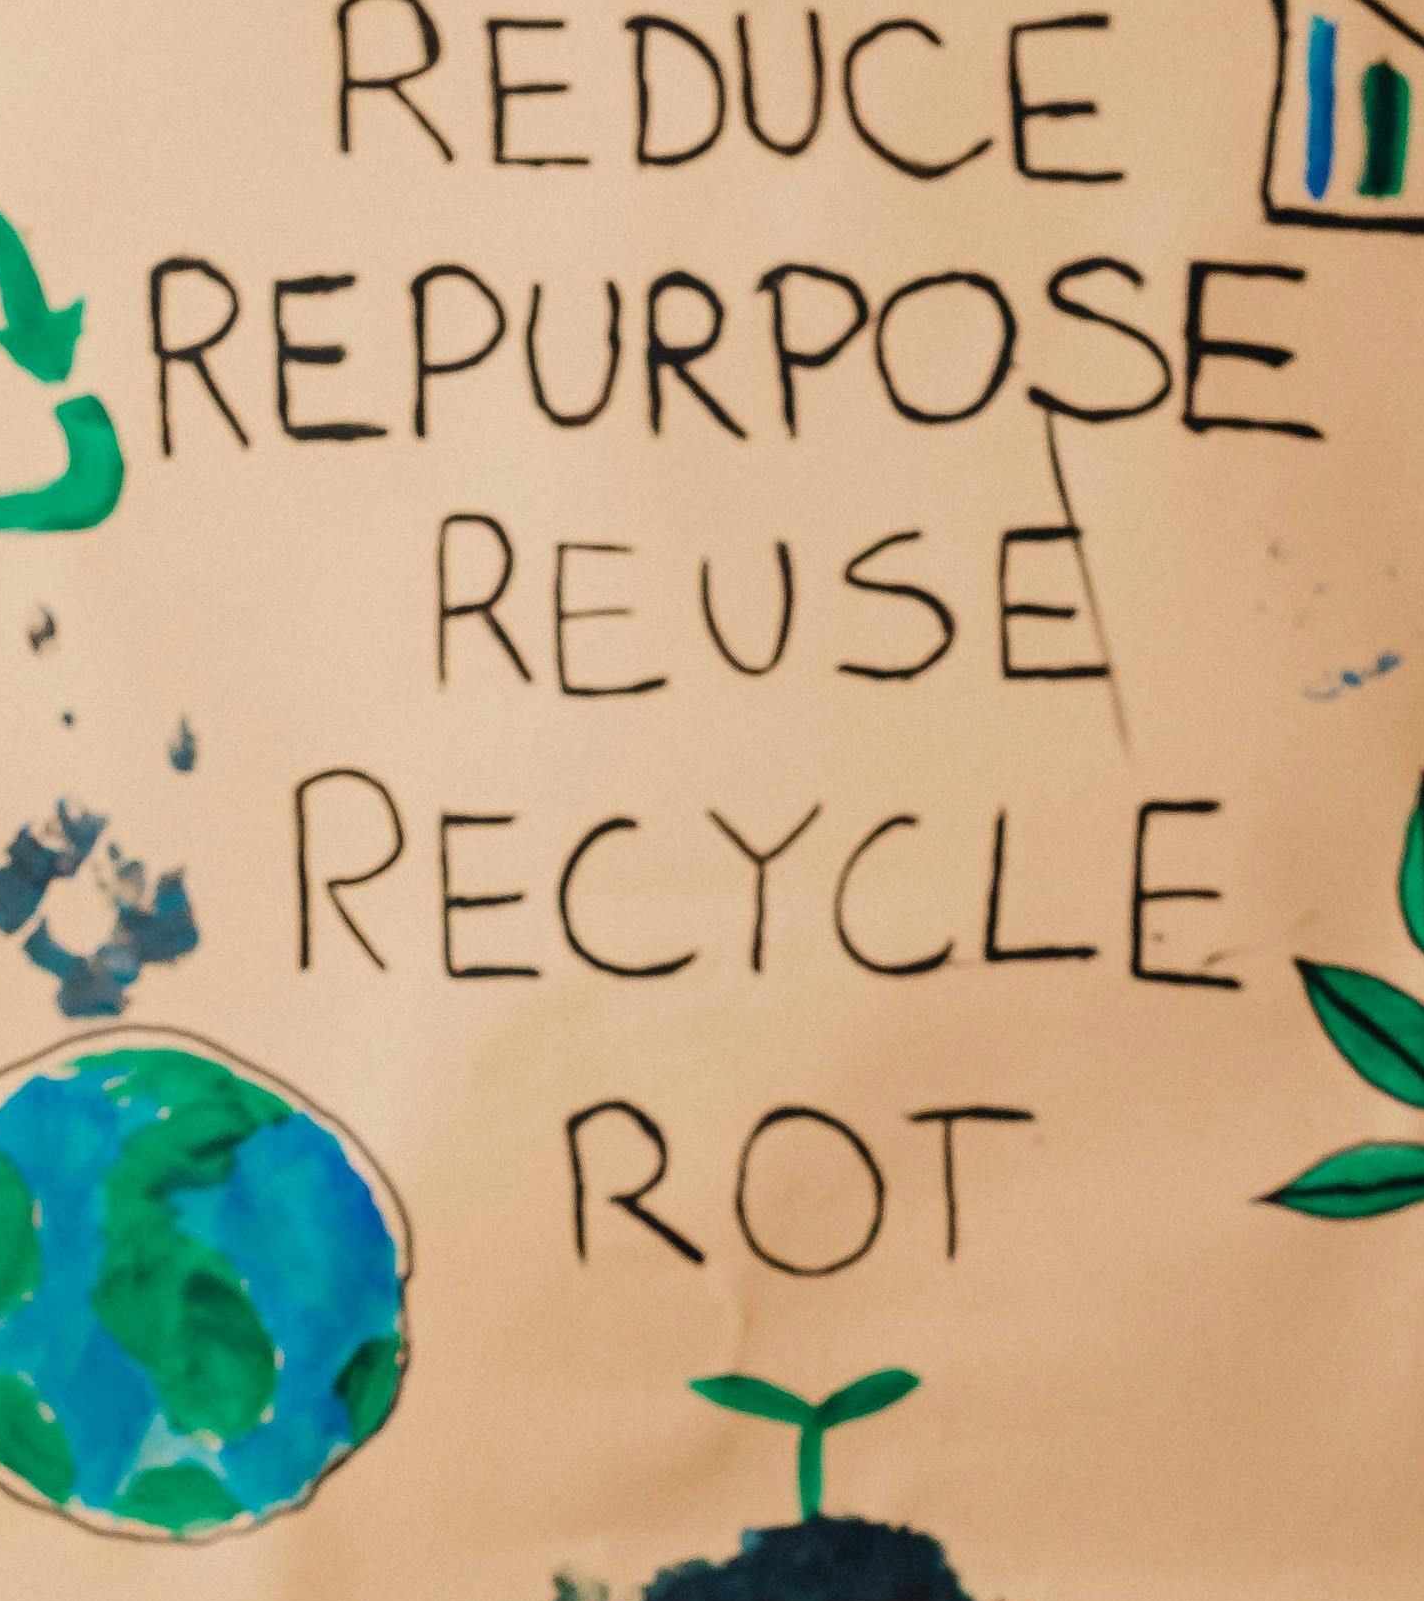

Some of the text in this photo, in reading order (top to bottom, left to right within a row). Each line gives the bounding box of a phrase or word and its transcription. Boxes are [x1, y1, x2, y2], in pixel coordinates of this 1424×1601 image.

[147, 254, 1327, 459] REPURPOSE
[435, 511, 1115, 699] REUSE
[292, 767, 1244, 992] RECYCLE
[563, 1097, 1037, 1279] ROT
